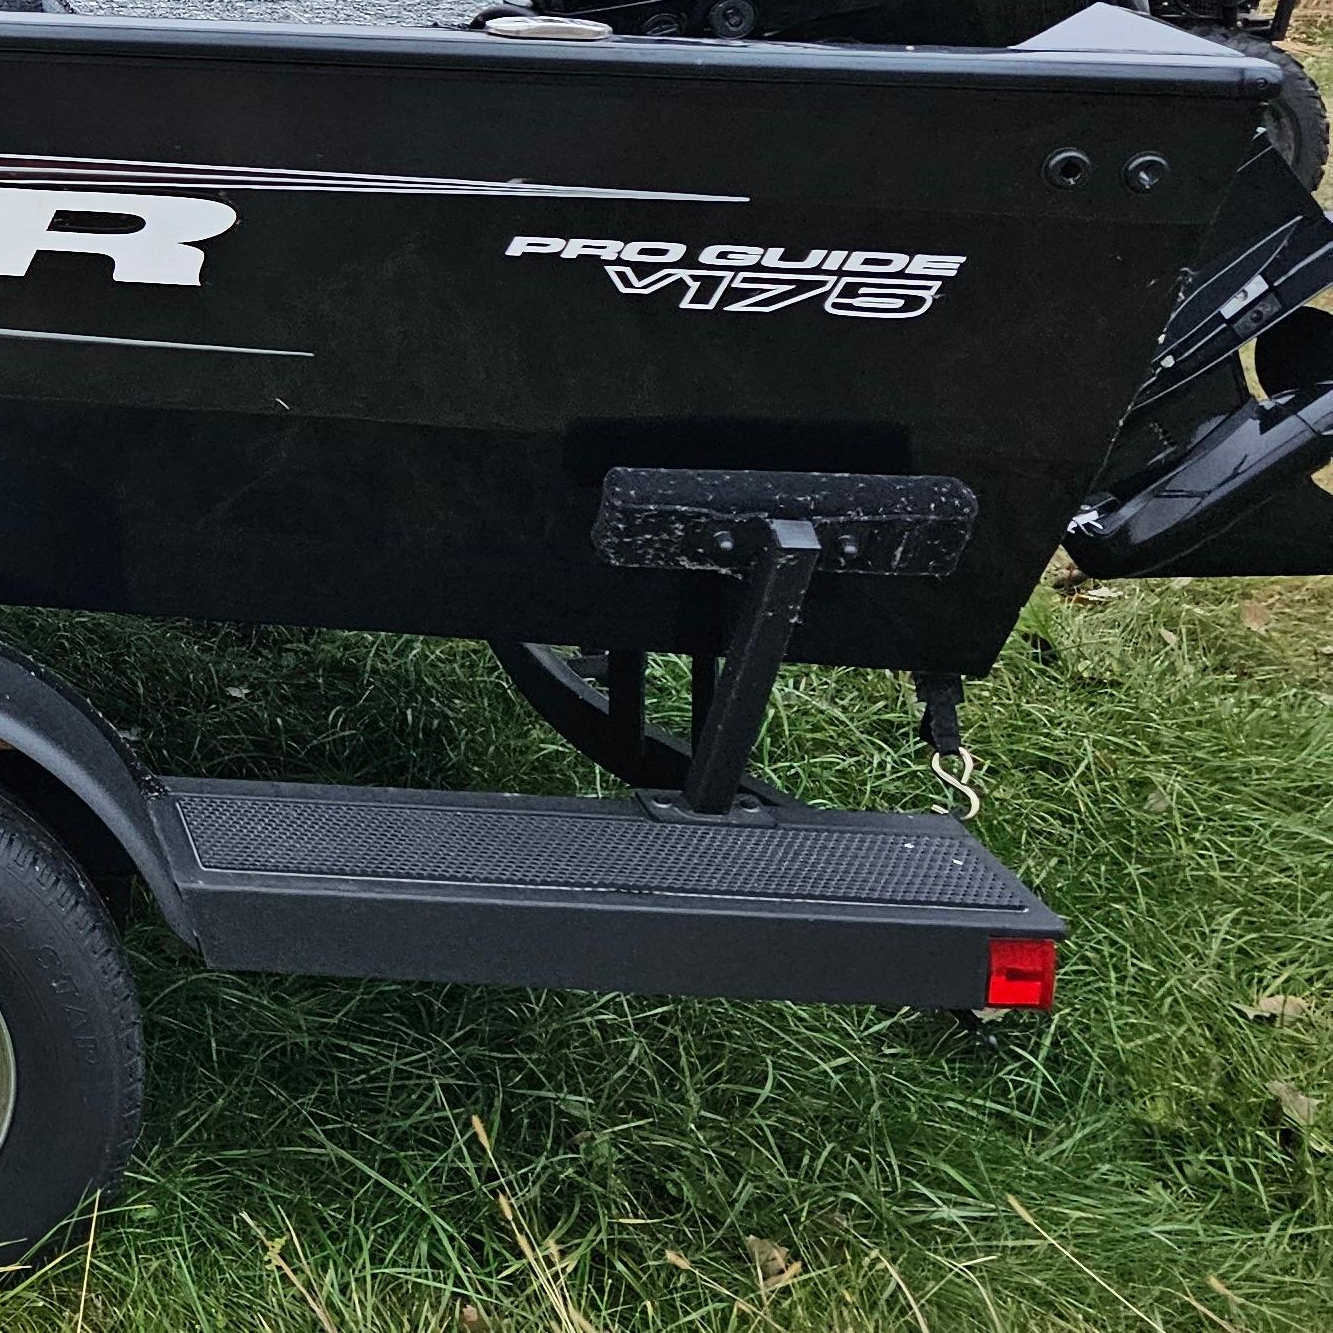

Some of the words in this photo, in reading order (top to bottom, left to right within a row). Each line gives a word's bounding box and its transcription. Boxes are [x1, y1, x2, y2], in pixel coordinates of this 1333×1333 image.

[504, 236, 687, 263] PRO
[697, 244, 967, 277] GUIDE
[603, 265, 943, 319] V175
